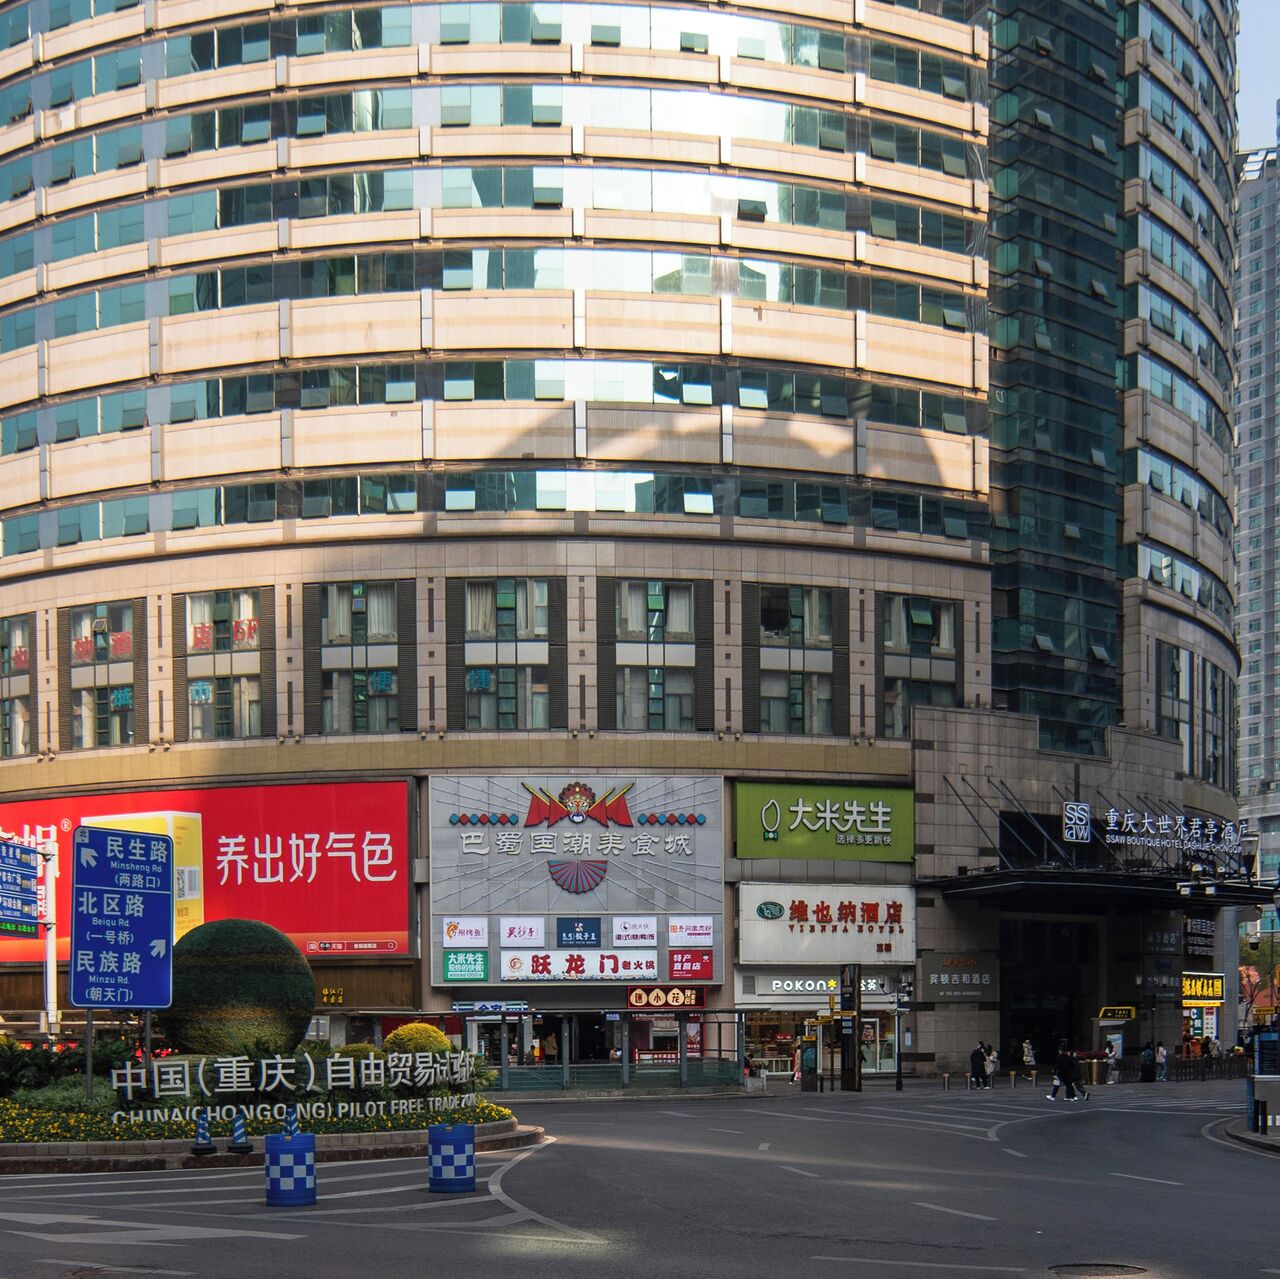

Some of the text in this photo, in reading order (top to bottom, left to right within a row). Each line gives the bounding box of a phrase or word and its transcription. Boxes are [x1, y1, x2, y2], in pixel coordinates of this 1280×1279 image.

[789, 798, 892, 832] 大米先生
[107, 836, 168, 863] 民生路
[460, 832, 694, 856] 巴蜀国潮美食城
[1161, 838, 1183, 849] HOTEL
[216, 831, 397, 886] 养出好气色
[110, 861, 150, 873] Minsheng
[115, 873, 161, 889] (两路口)
[78, 892, 145, 917] 北区路
[789, 900, 904, 925] 维也纳酒店
[92, 917, 117, 927] Beiqu
[789, 925, 905, 934] VIENNA HOTEL
[86, 931, 134, 945] (一号桥)
[76, 950, 142, 974] 民族路
[448, 953, 483, 964] 大米先生
[531, 954, 655, 974] 跃龙门 老火锅
[673, 954, 692, 962] 特产
[89, 975, 115, 984] Minzu
[85, 987, 133, 1002] (朝天门)
[338, 1101, 387, 1118] PILOT
[390, 1098, 424, 1115] FREE
[427, 1095, 460, 1111] TRADE
